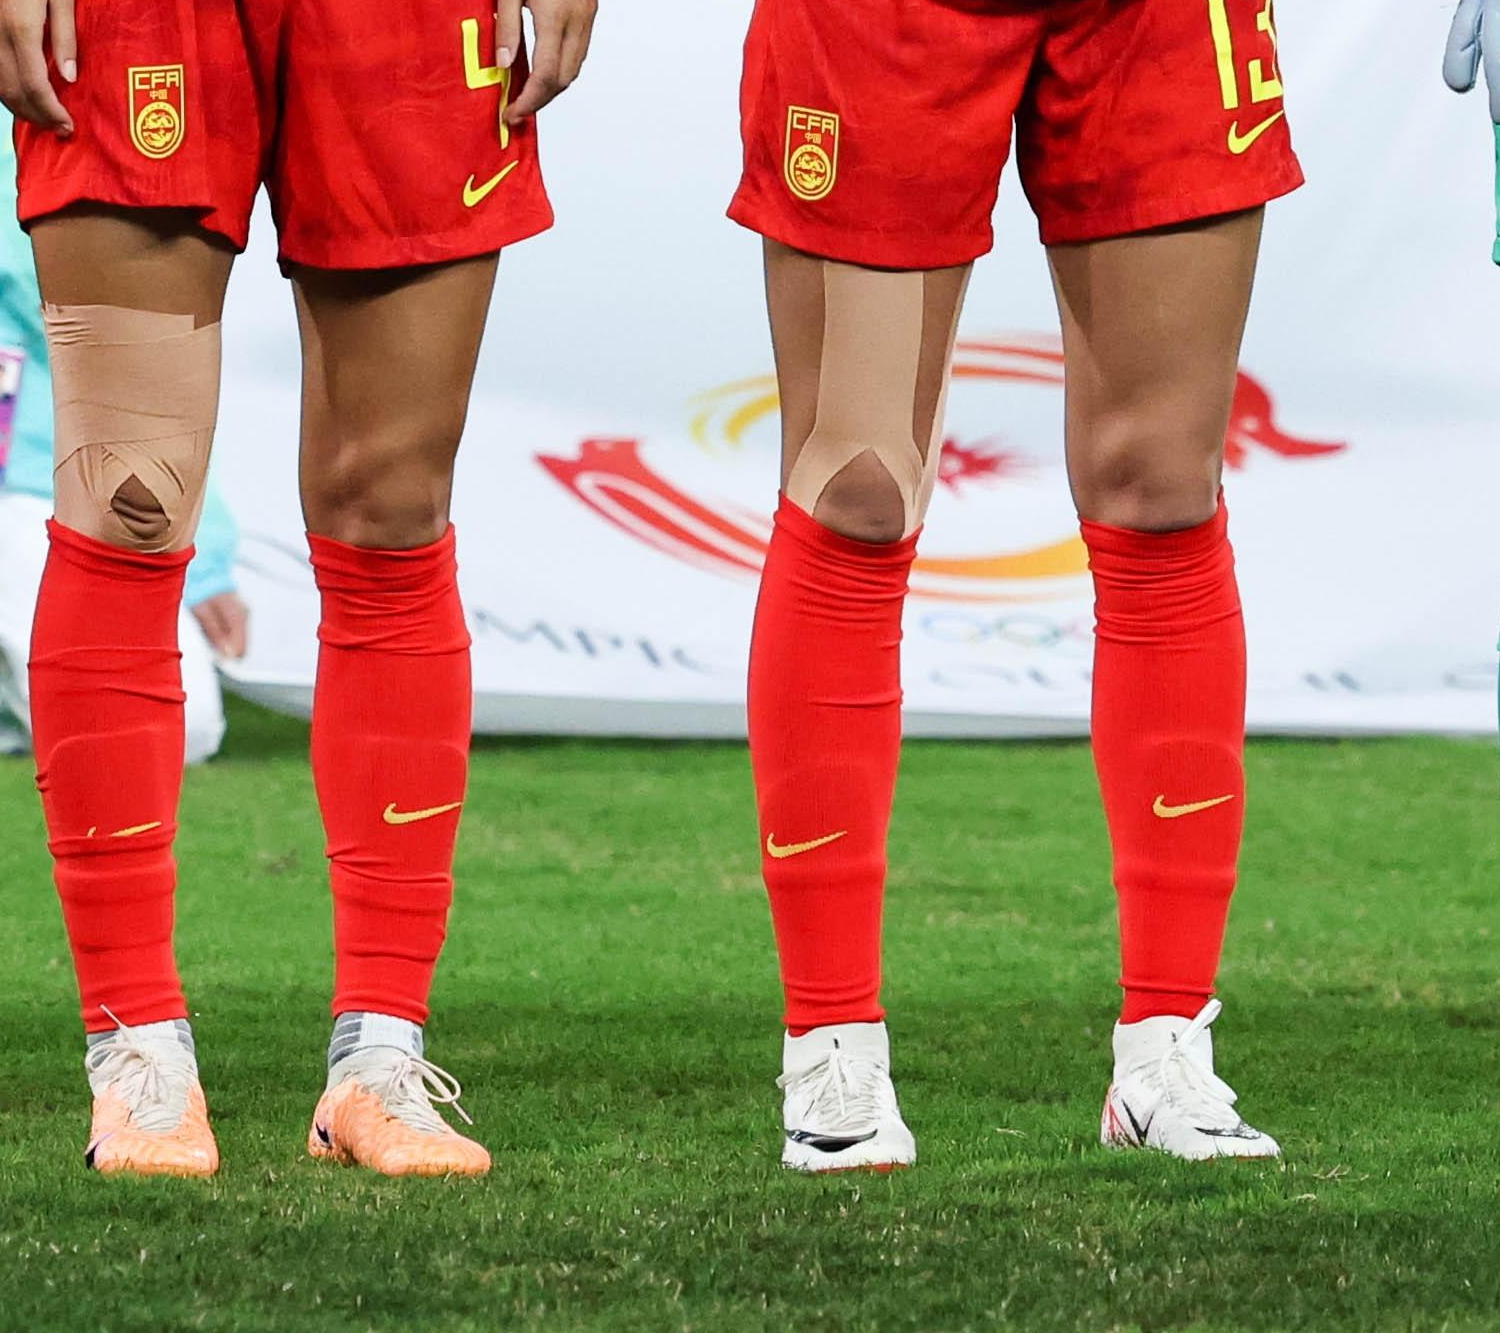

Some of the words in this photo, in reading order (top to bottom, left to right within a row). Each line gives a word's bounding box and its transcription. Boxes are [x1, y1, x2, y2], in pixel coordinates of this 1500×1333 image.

[134, 71, 180, 90] CFA
[461, 17, 511, 150] 4
[150, 88, 168, 100] 中国
[792, 113, 835, 135] CFA
